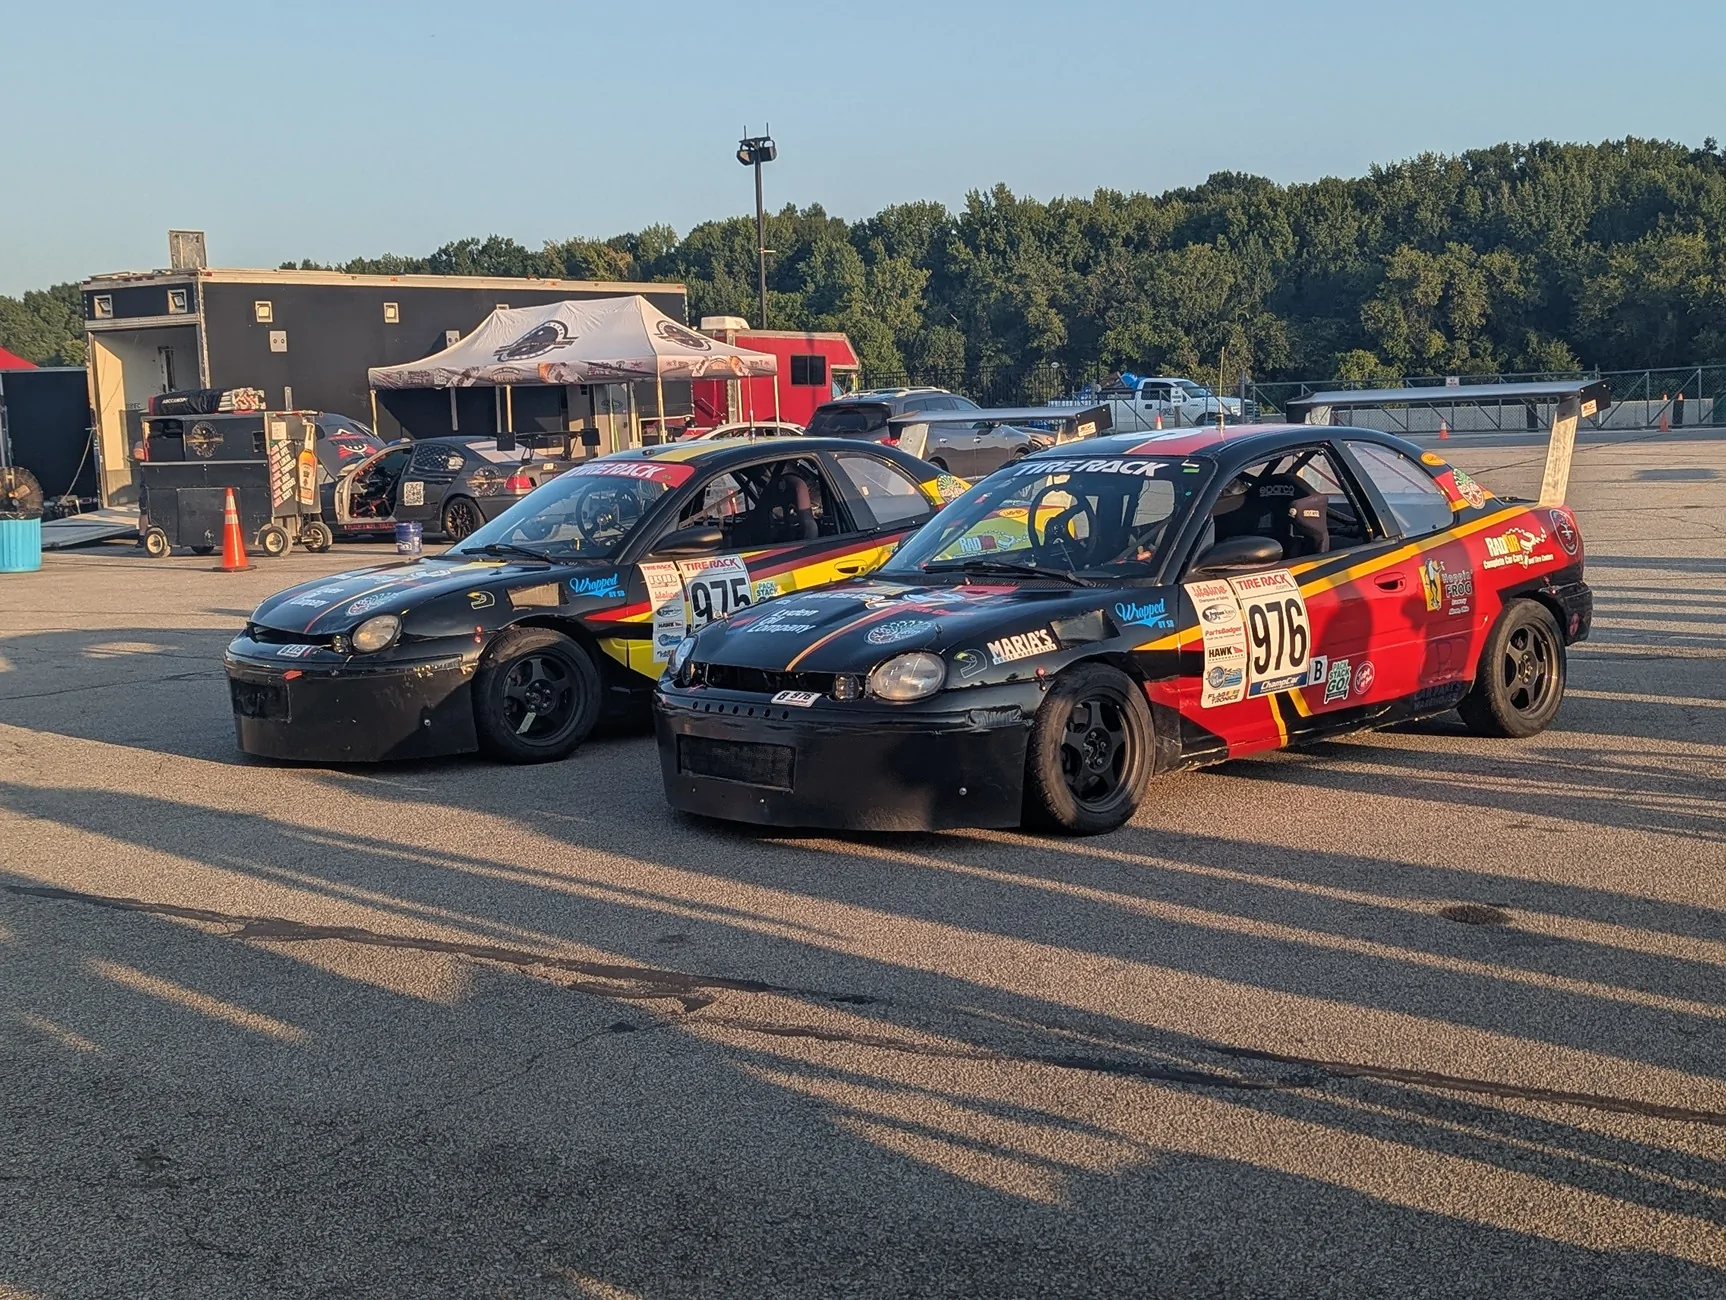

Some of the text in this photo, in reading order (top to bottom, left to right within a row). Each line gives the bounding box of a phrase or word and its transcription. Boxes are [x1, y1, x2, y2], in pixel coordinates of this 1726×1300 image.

[607, 463, 666, 479] RACK
[1013, 460, 1169, 477] TIRE RACK
[684, 558, 742, 574] TIRE RACK
[569, 572, 619, 594] Wrapped
[758, 581, 775, 590] PACK
[1236, 574, 1294, 591] TIRE RACK
[1445, 581, 1472, 599] FROG
[756, 587, 779, 597] STACK
[1115, 597, 1166, 621] Wrapped
[746, 623, 817, 635] Company
[1205, 625, 1242, 637] PartsBadger
[1249, 598, 1307, 675] 976
[986, 628, 1053, 660] MARIA'S
[1208, 645, 1233, 658] HAWK
[1314, 660, 1323, 681] B
[1329, 668, 1351, 680] STACK
[1260, 674, 1302, 691] ChampCar
[1327, 677, 1350, 693] GO!
[789, 692, 814, 701] 976
